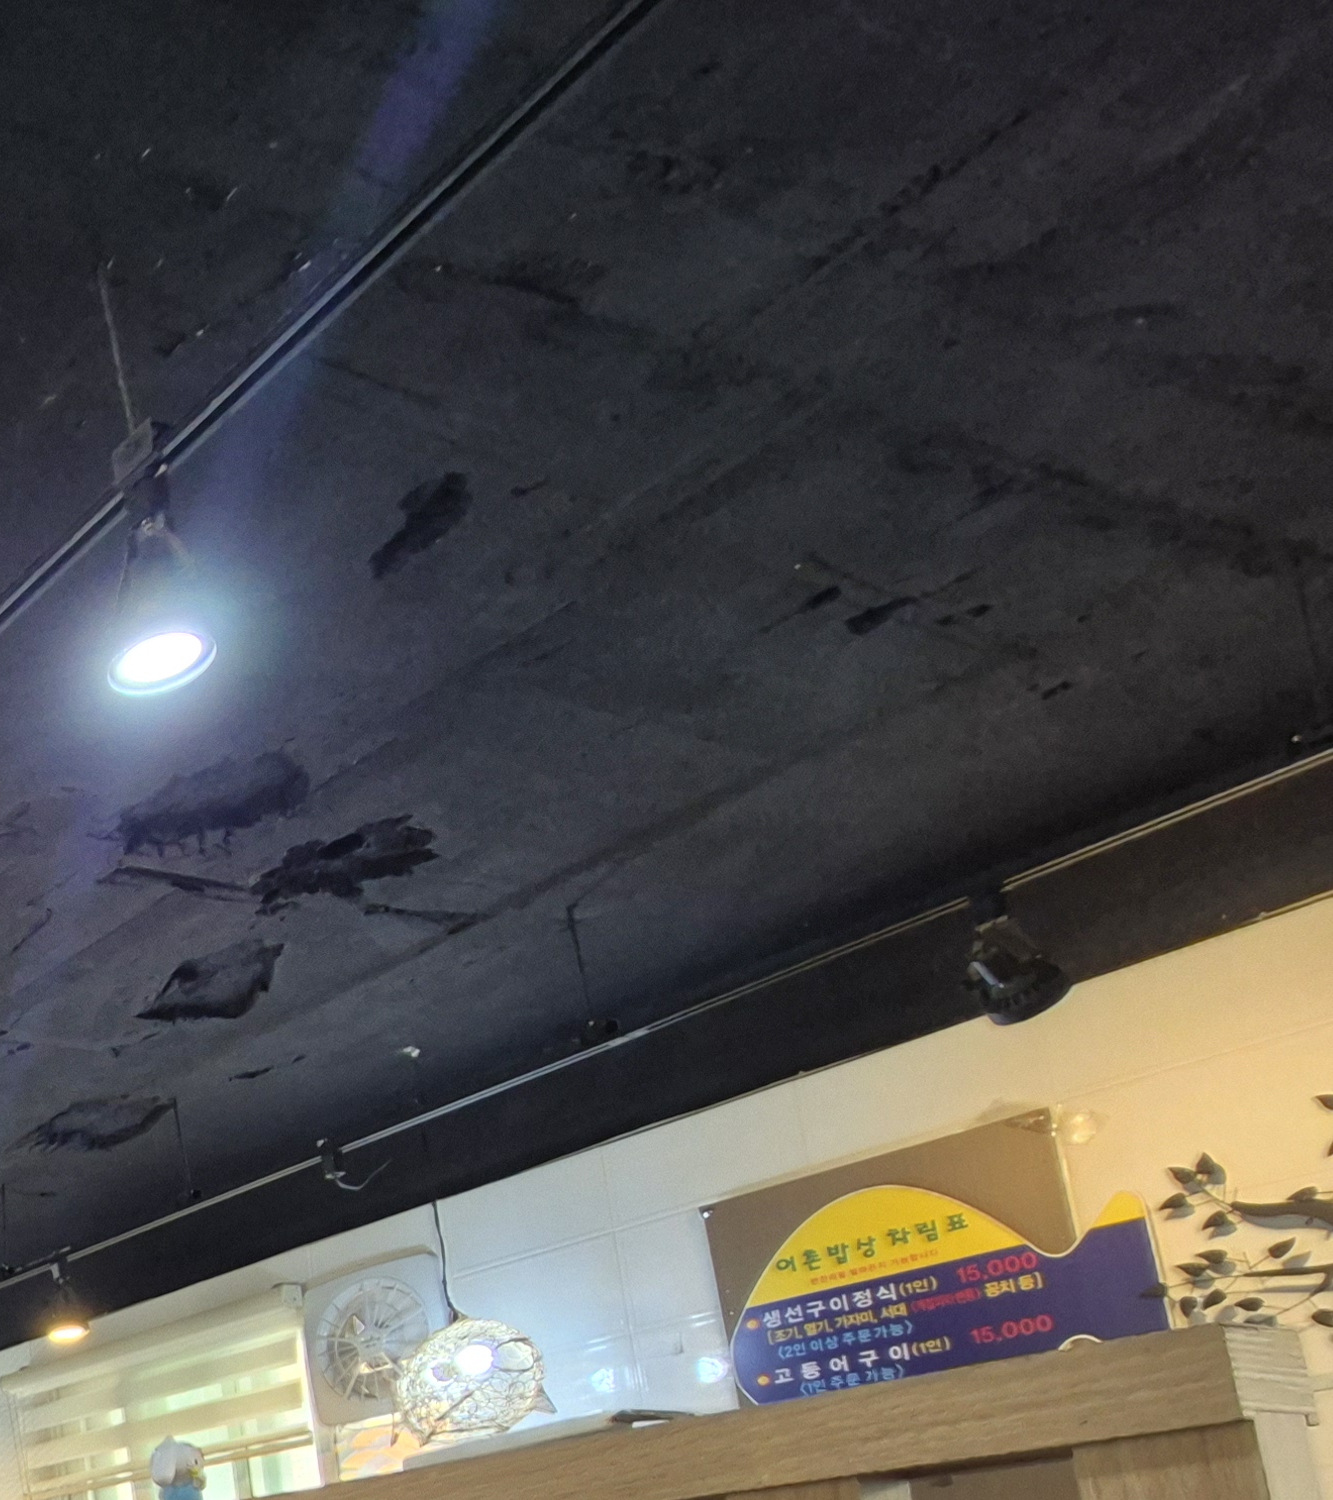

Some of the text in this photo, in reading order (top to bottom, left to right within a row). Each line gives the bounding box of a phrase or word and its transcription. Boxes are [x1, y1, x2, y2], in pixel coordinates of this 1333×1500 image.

[776, 1213, 969, 1273] 어촌밥상 차림표
[809, 1335, 839, 1354] 이상
